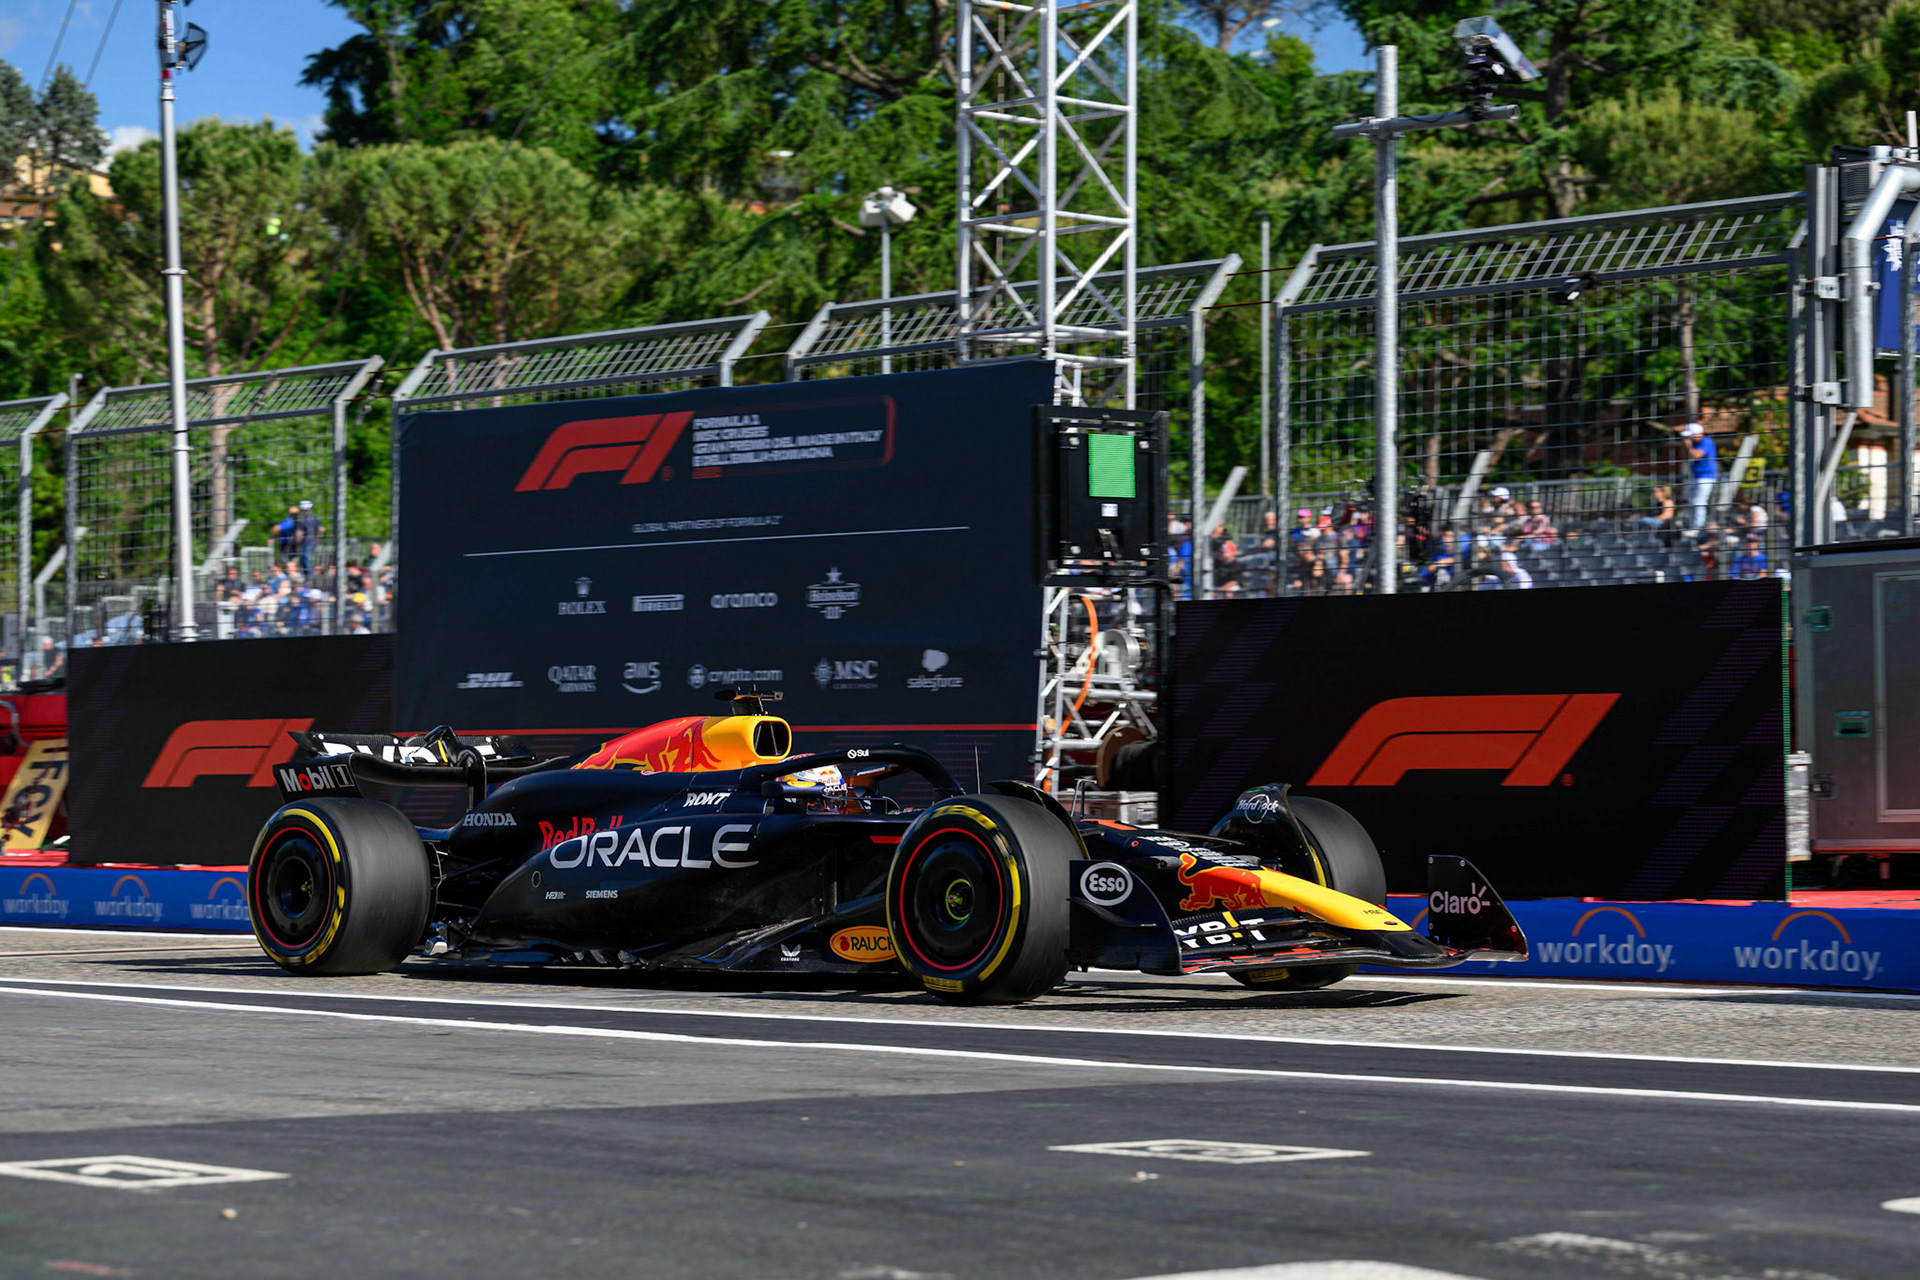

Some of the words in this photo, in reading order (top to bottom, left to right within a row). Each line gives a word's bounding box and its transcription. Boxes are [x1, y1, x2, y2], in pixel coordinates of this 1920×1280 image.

[692, 415, 750, 430] FORMULA
[557, 600, 606, 615] ROLEX
[632, 594, 685, 612] PIRELLI
[710, 592, 777, 609] aramco
[548, 665, 597, 684] QATAR
[708, 668, 783, 685] crypto.com
[833, 660, 878, 680] MSC
[907, 675, 963, 692] salesforce
[1305, 693, 1624, 786] F1
[279, 765, 336, 793] Mobil
[462, 812, 517, 827] HONDA
[538, 816, 578, 852] Red
[581, 815, 623, 836] Bll
[549, 824, 760, 870] ORACLE
[1089, 873, 1126, 893] Esso
[585, 890, 619, 899] SIEMENS
[1430, 891, 1482, 914] Claro
[4, 894, 69, 919] workday
[94, 896, 163, 921] workday
[190, 899, 251, 921] workda
